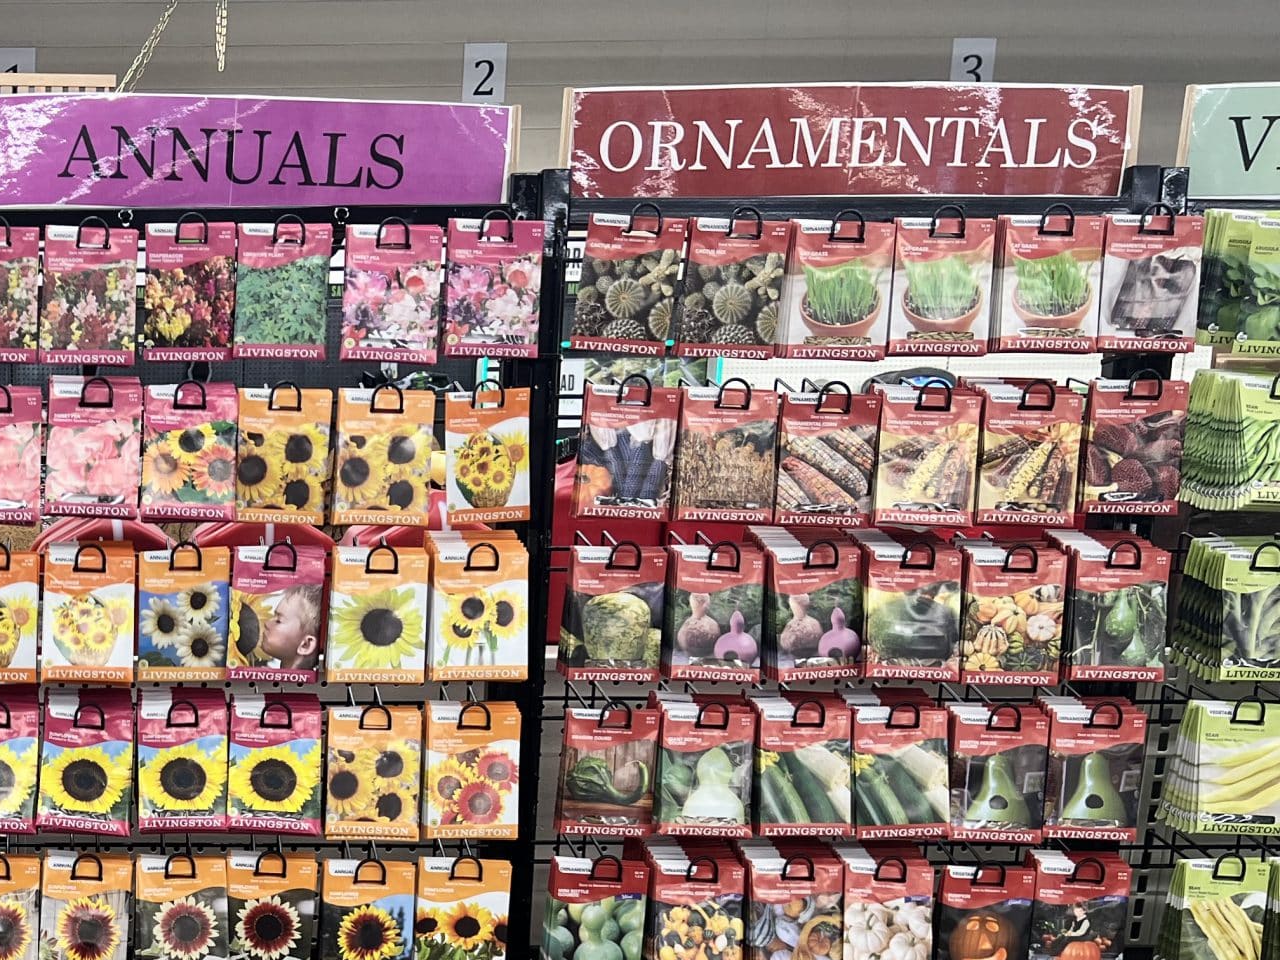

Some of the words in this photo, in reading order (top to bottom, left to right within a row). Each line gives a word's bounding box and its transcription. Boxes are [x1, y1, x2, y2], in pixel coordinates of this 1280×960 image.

[960, 55, 983, 82] 3
[472, 59, 496, 97] 2
[599, 116, 1100, 173] ORNAMENTALS
[57, 124, 406, 190] ANNUALS
[575, 341, 657, 354] LIVINGSTON
[895, 343, 979, 353] LIVINGSTON
[1105, 339, 1188, 350] LIVINGSTON
[148, 352, 224, 362] LIVINGSTON
[348, 351, 427, 361] LIVINGSTON
[685, 348, 766, 359] LIVINGSTON
[145, 507, 224, 518] LIVINGSTON
[685, 512, 764, 522] LIVINGSTON
[983, 514, 1066, 524] LIVINGSTON
[48, 670, 125, 680] LIVINGSTON
[574, 672, 651, 682] LIVINGSTON
[784, 669, 858, 680] LIVINGSTON
[1077, 670, 1156, 680] LIVINGSTON
[966, 675, 1048, 685] LIVINGSTON
[145, 819, 221, 829] LIVINGSTON
[668, 827, 745, 837] LIVINGSTON
[862, 827, 943, 838] LIVINGSTON
[1049, 830, 1129, 840] LIVINGSTON
